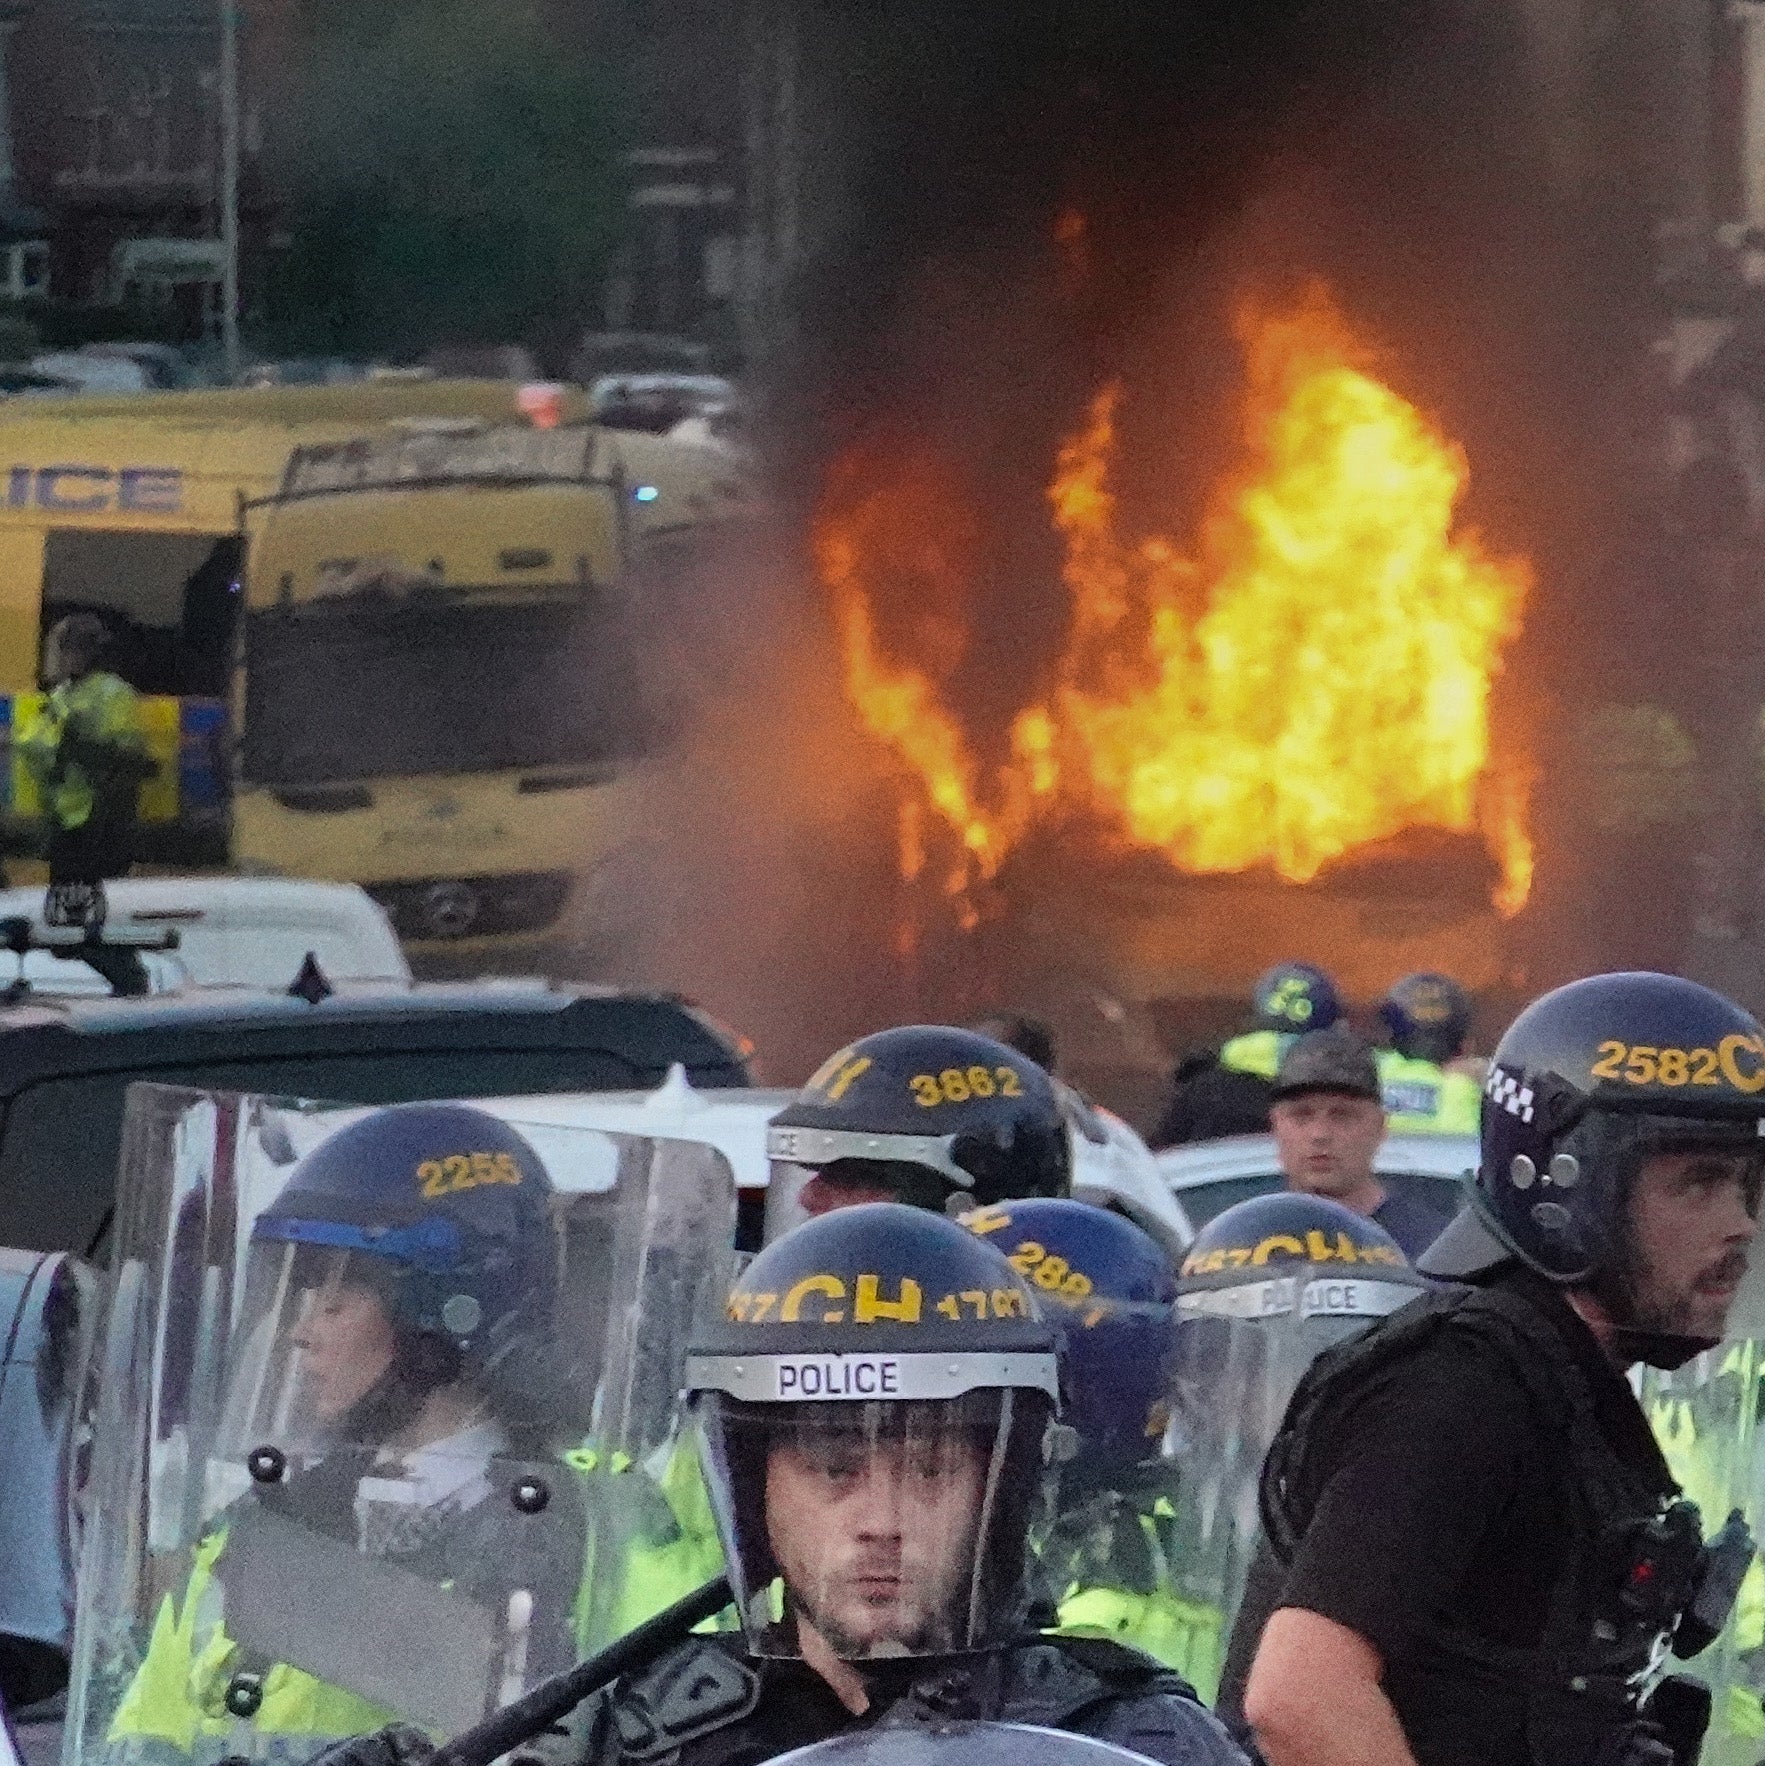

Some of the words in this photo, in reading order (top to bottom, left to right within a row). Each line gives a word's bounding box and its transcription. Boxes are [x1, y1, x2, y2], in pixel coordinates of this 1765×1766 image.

[1591, 1040, 1723, 1086] 2582
[779, 1274, 923, 1324] CH
[780, 1362, 897, 1397] POLICE
